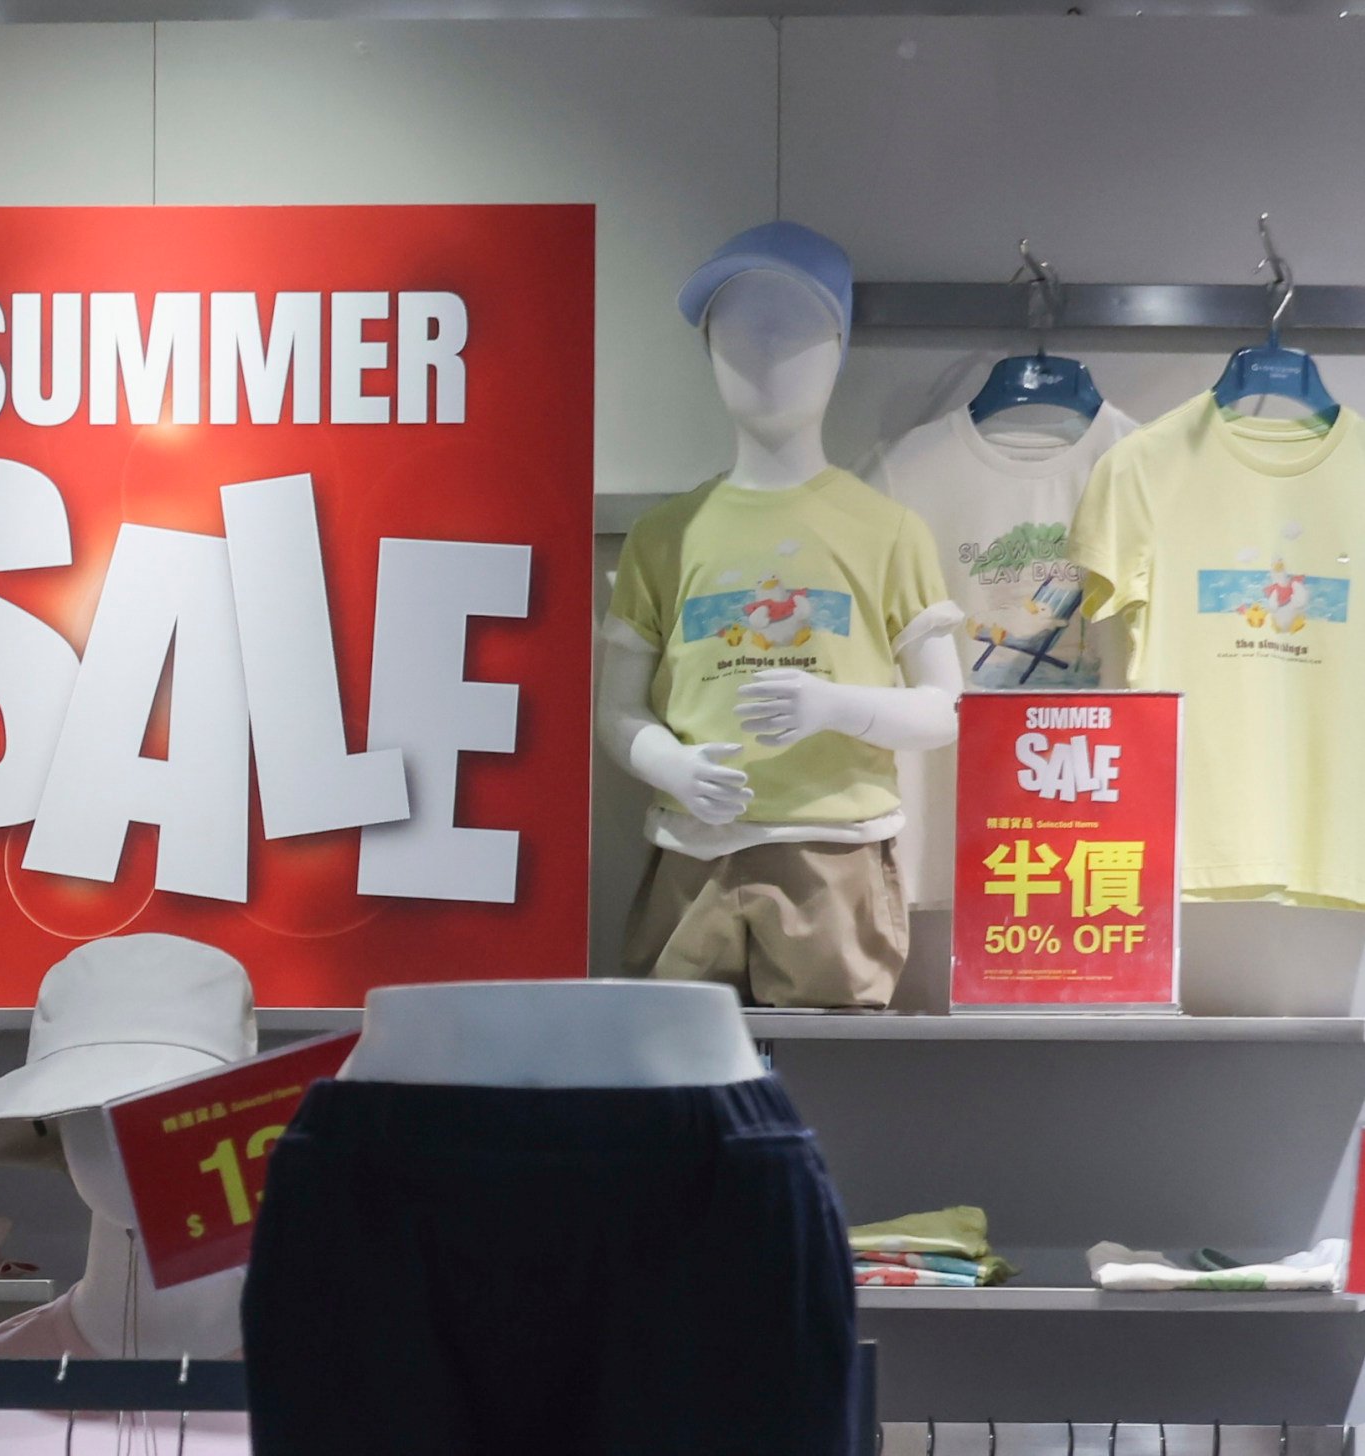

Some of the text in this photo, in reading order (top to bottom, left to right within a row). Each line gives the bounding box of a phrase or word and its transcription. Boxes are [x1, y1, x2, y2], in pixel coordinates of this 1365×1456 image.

[958, 541, 1029, 563] SLOW
[978, 562, 1025, 586] LAY
[735, 655, 775, 667] simple
[778, 655, 817, 667] things
[1025, 707, 1112, 730] SUMMER
[1015, 732, 1122, 802] SALE
[982, 840, 1146, 918] 半價
[984, 924, 1146, 954] 50% OFF
